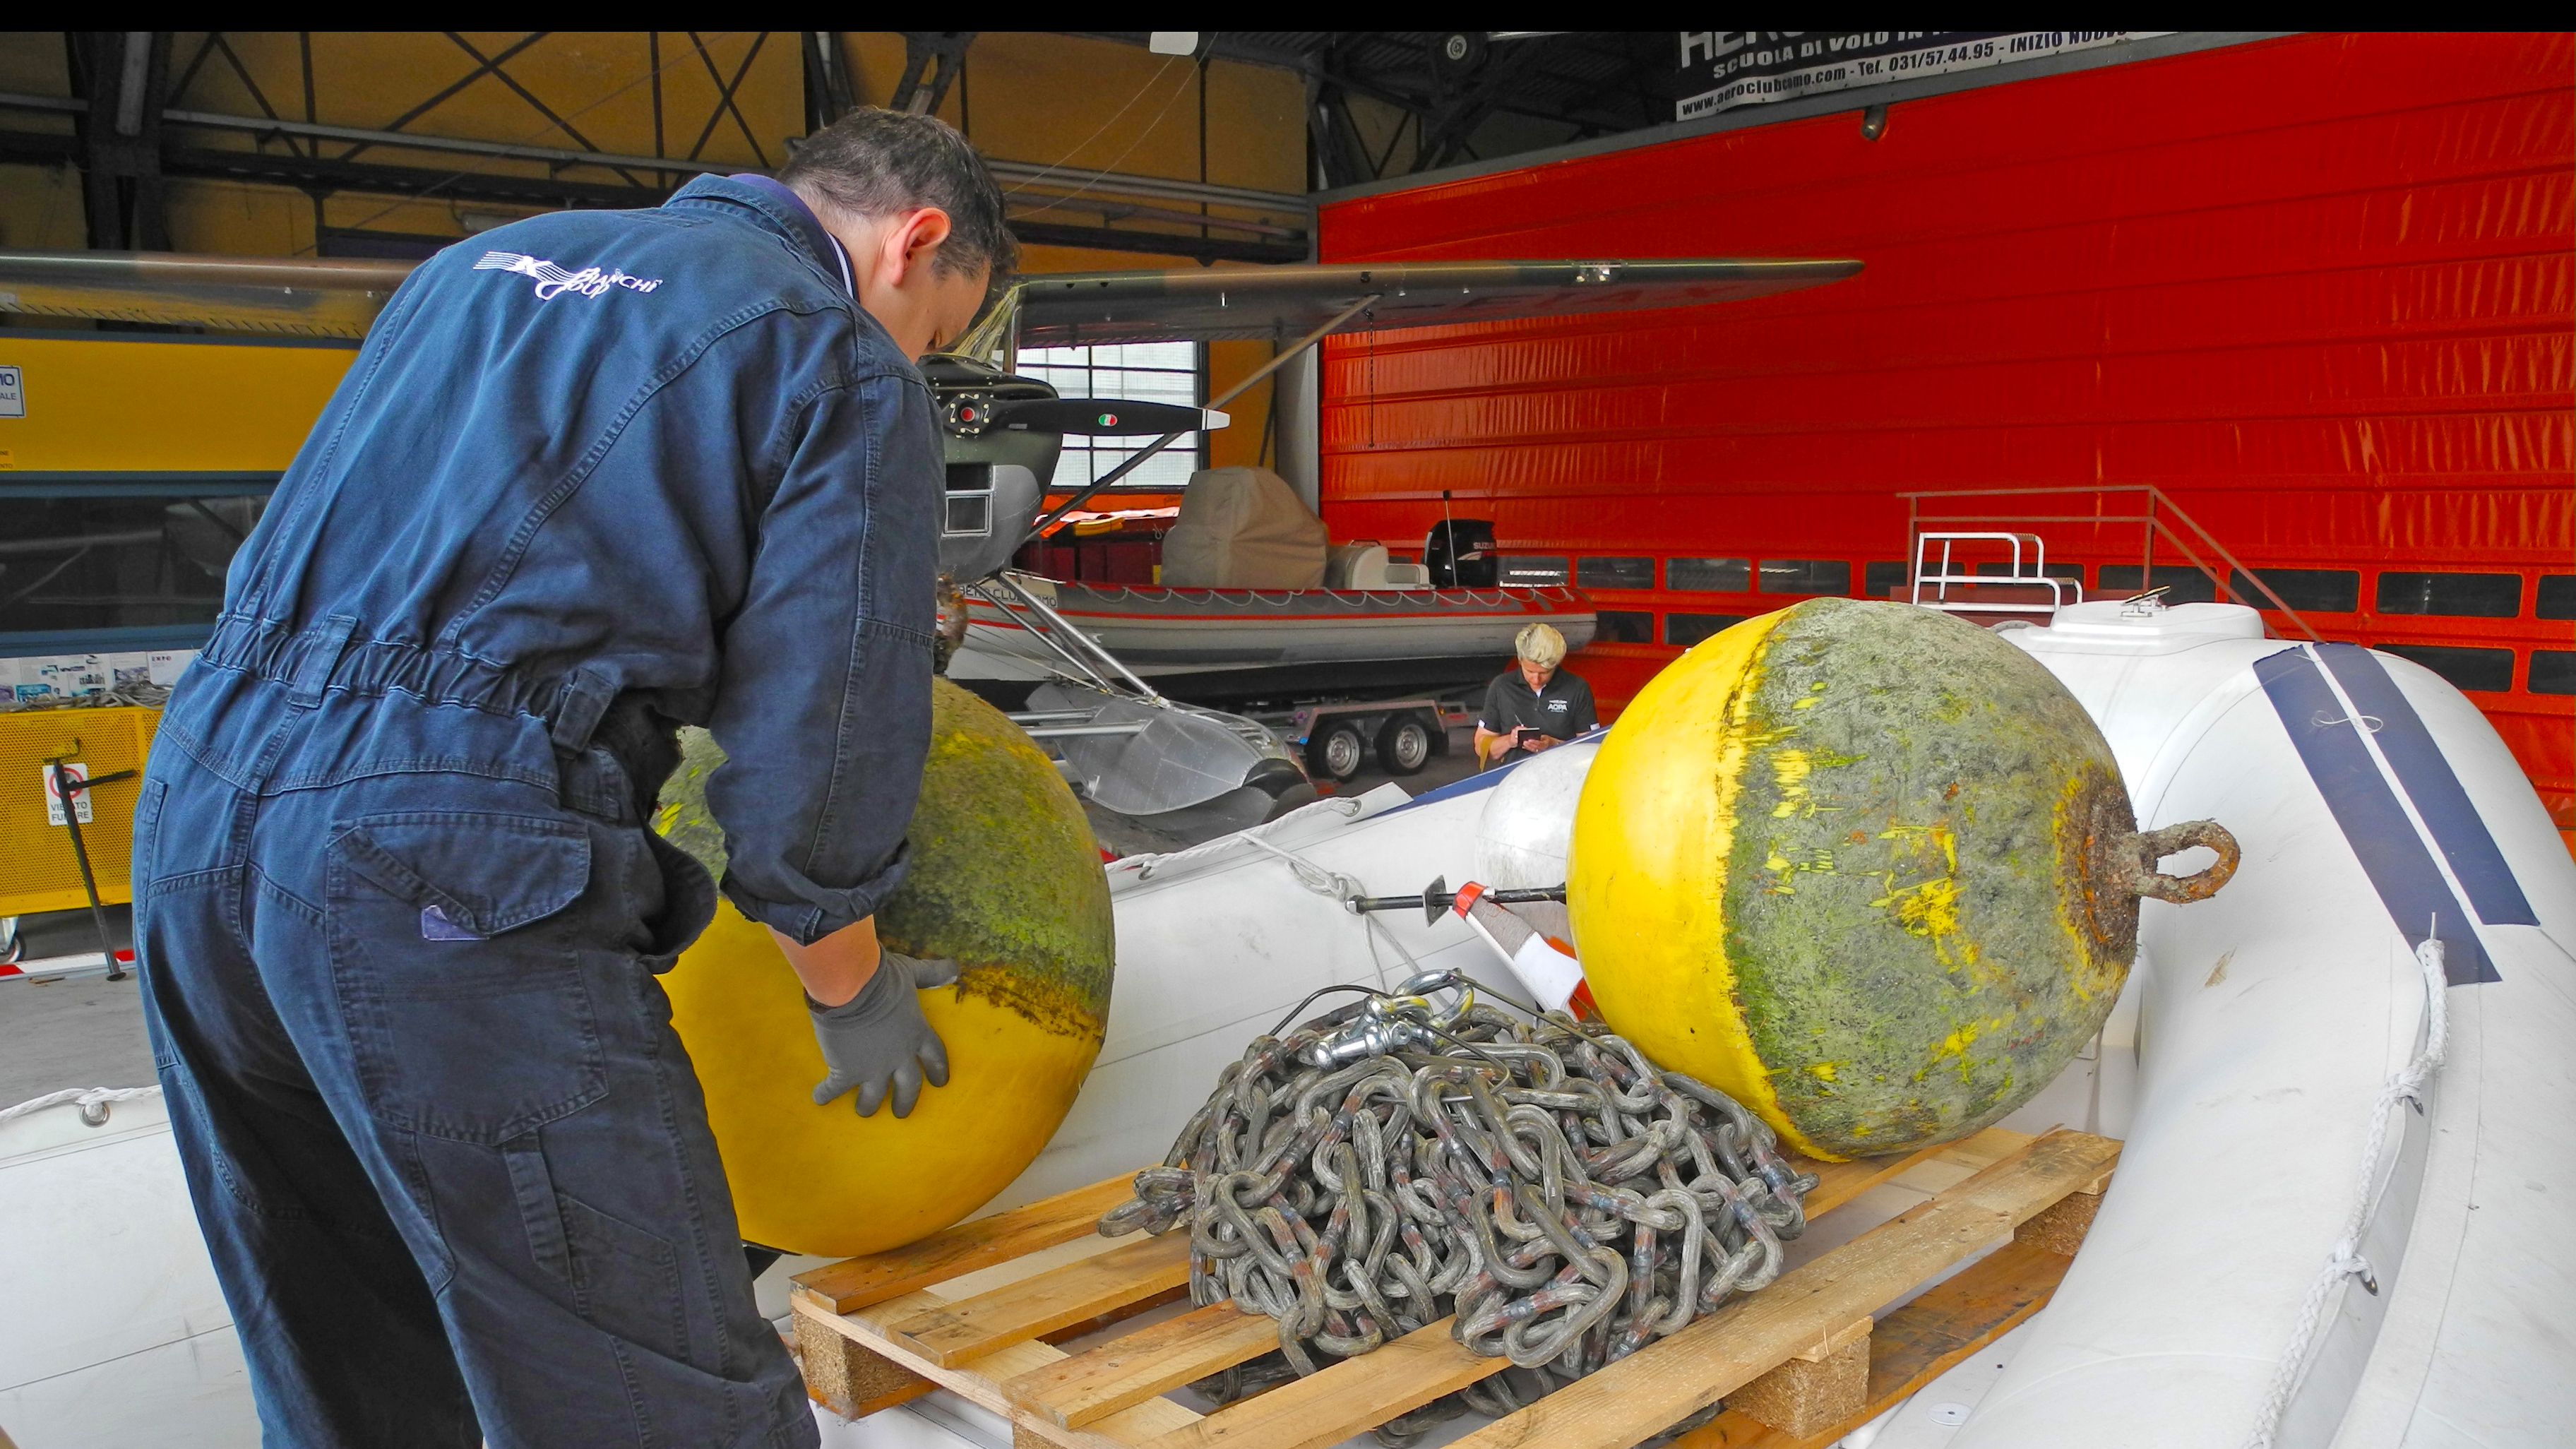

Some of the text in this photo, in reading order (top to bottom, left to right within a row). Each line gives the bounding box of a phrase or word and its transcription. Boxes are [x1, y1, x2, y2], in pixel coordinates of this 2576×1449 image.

[1713, 45, 1794, 79] SCUOLA
[1801, 40, 1822, 58] DI
[1829, 32, 1889, 52] VOLO
[1682, 66, 1846, 115] www.aeroclubcomo.com
[1858, 59, 1884, 76] Tel.
[1889, 41, 1994, 72] 031/57.44.95
[2010, 32, 2063, 54] INIZIO
[50, 801, 88, 811] VIETO
[52, 811, 90, 821] FURE
